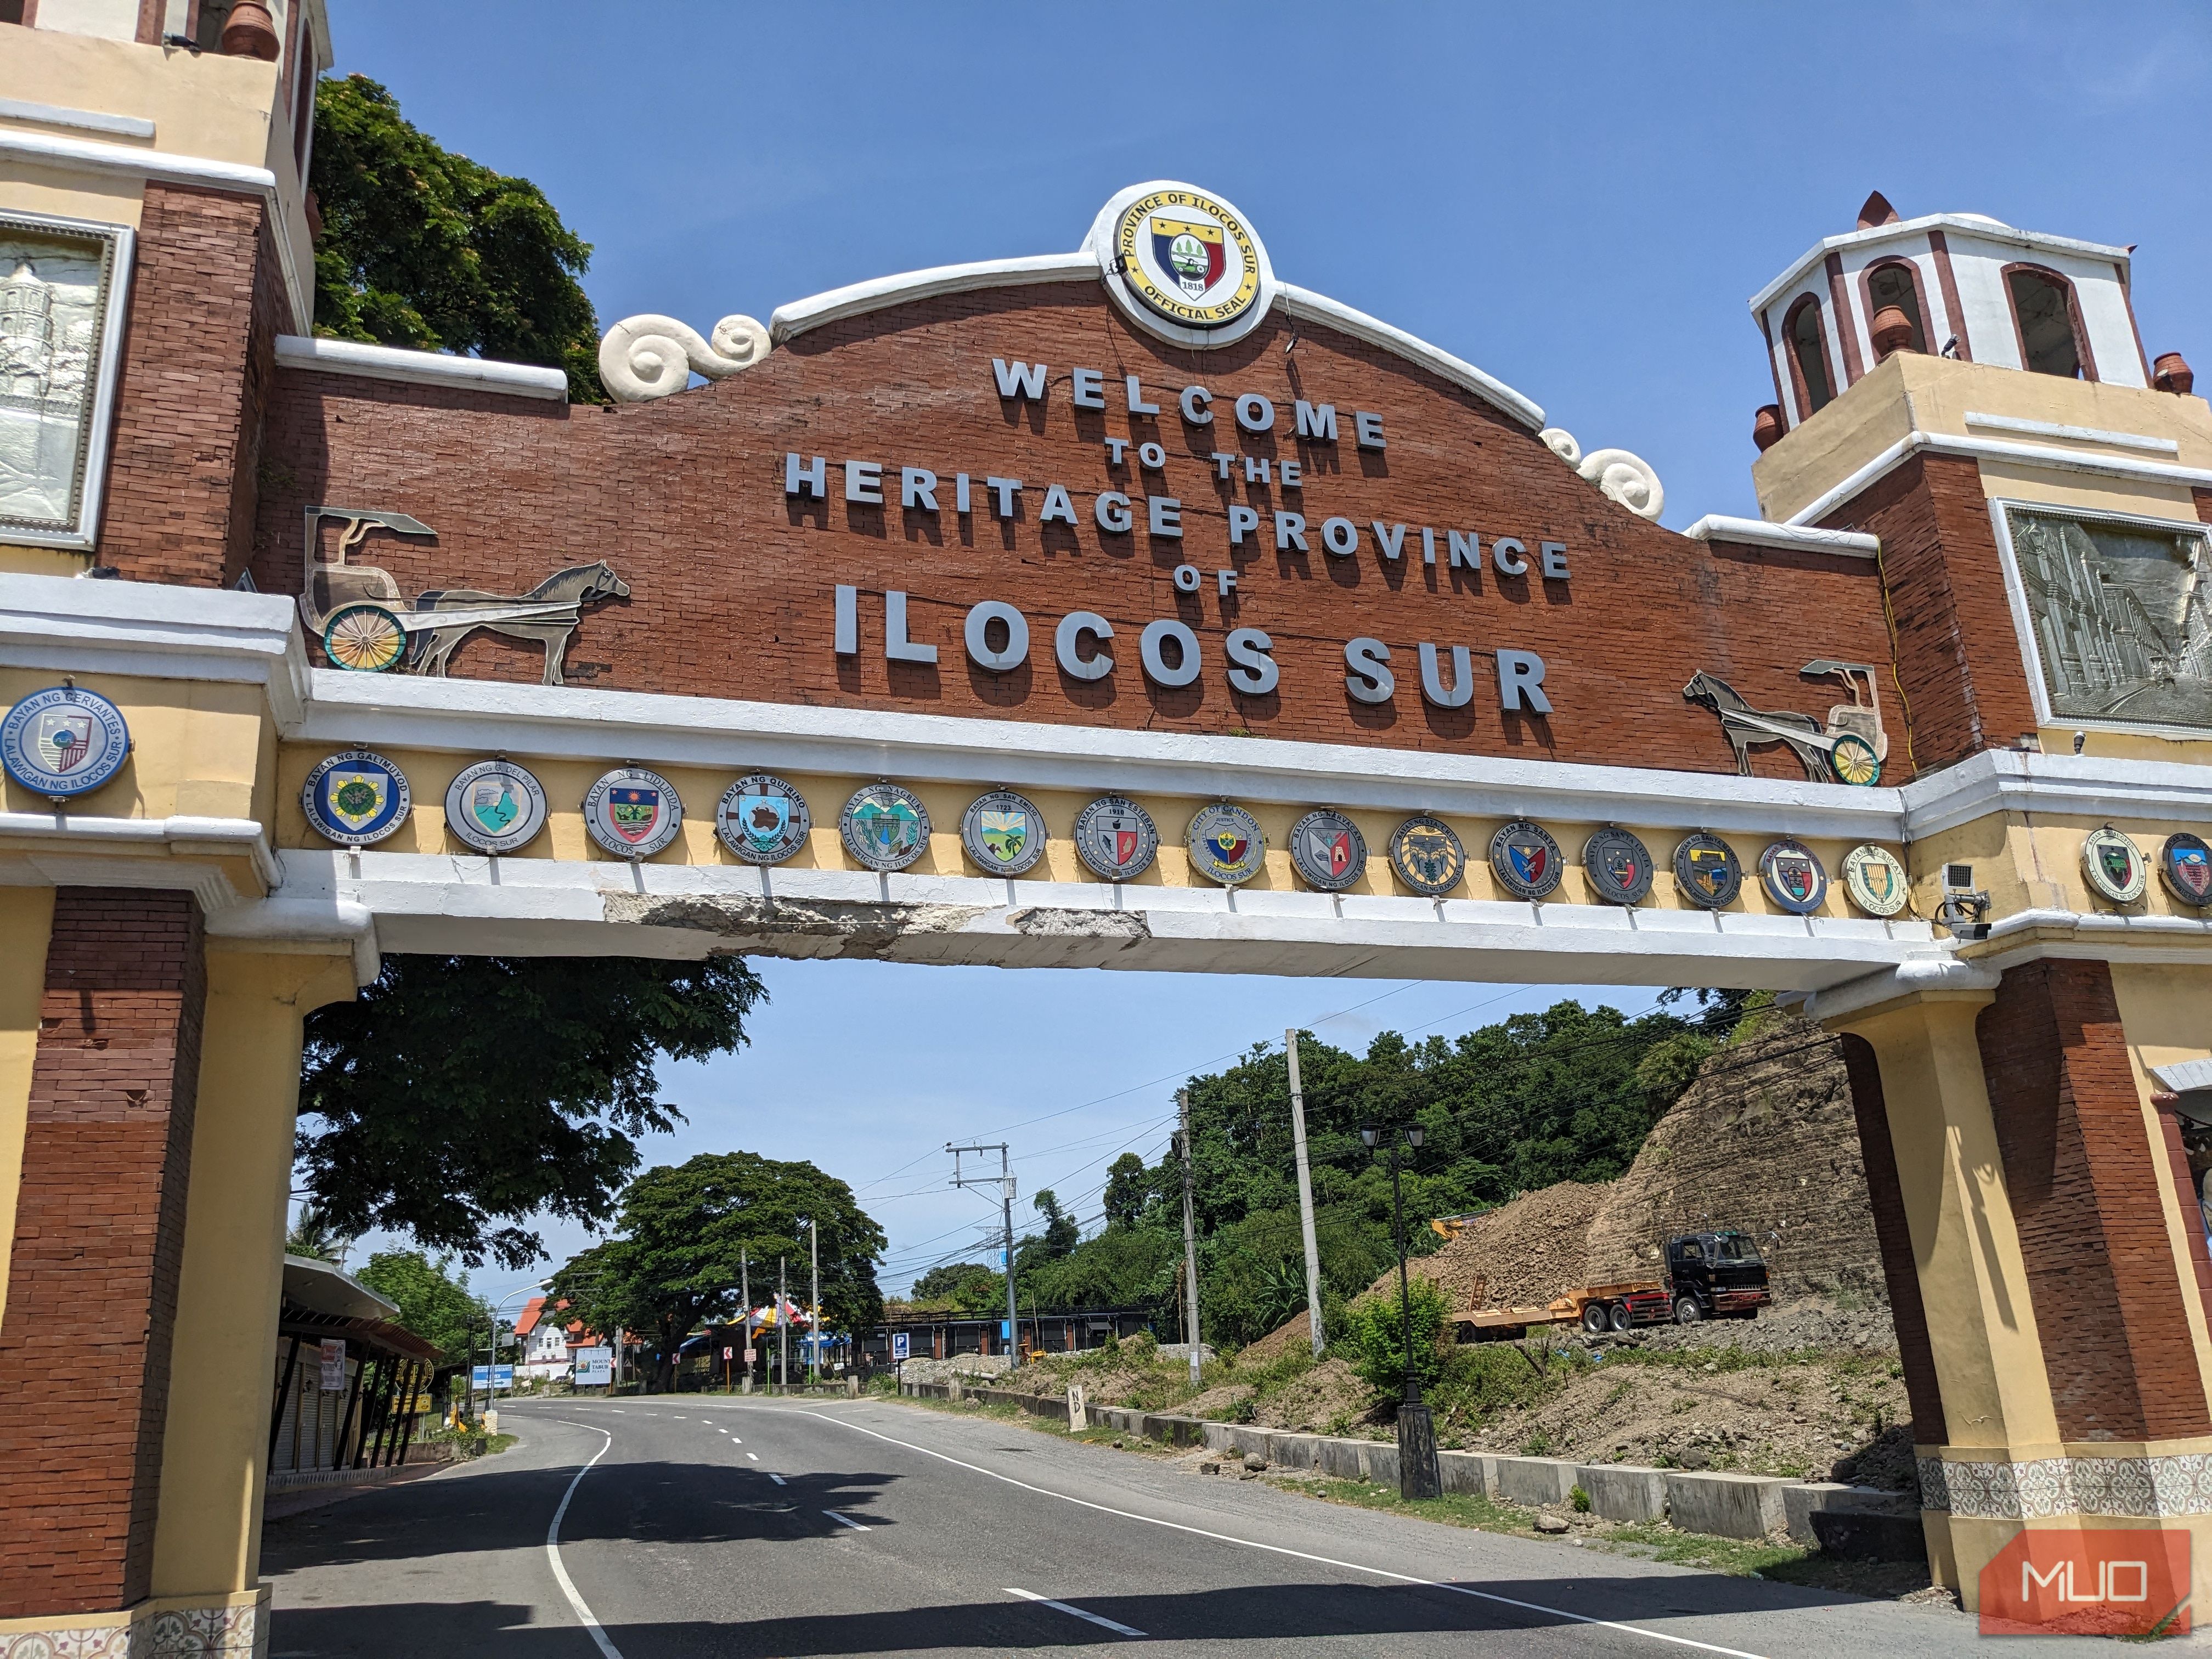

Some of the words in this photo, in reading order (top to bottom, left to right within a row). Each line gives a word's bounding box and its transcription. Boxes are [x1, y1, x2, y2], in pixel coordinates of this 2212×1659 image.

[1124, 196, 1163, 257] PROVINCE
[1168, 194, 1187, 204] OF
[1192, 197, 1245, 241] ILOCOS
[1240, 245, 1255, 274] SUR
[1182, 281, 1204, 291] 1818
[1144, 286, 1213, 319] OFFICIAL
[1215, 295, 1246, 318] SEAL
[991, 358, 1387, 450] WELCOME
[1104, 437, 1166, 470] TO
[1211, 452, 1302, 487] THE
[785, 452, 1183, 538] HERITAGE
[1227, 505, 1571, 580] PROVINCE
[1172, 565, 1238, 597] OF
[835, 584, 1279, 695] ILOCOS
[1344, 637, 1554, 715] SUR
[8, 699, 41, 729] BAYAN
[43, 693, 60, 703] NG
[65, 692, 121, 735] CERVANTES
[5, 738, 48, 787] LALAWIGAN
[50, 780, 67, 789] NG
[71, 763, 111, 788] ILOCOS
[108, 741, 122, 762] SUR
[308, 759, 335, 787] BAYAN
[337, 753, 353, 762] NG
[357, 753, 407, 792] GALIMUYOD
[455, 770, 478, 791] BAYAN
[479, 765, 492, 773] NG
[506, 766, 520, 778] DEL
[522, 775, 539, 796] PILAR
[588, 778, 609, 806] BAYAN
[618, 770, 633, 778] NG
[644, 772, 679, 811] LIDLIDDA
[721, 780, 748, 804] BAYAN
[770, 778, 805, 808] QUIRINO
[844, 792, 865, 817] BAYAN
[888, 786, 927, 821] NAGBUKEL
[970, 798, 987, 812] BAYAN
[1019, 800, 1037, 816] EMILIO
[1078, 807, 1094, 830] BAYAN
[1095, 800, 1107, 808] NG
[1128, 803, 1155, 834] ESTEBAN
[306, 803, 343, 840] LALAWIGAN
[364, 823, 396, 840] ILOCOS
[395, 806, 407, 821] SUR
[1193, 812, 1207, 830] CITY
[1223, 806, 1259, 831] CANDON
[1294, 817, 1310, 838] BAYAN
[1327, 812, 1362, 841] NARVACAN
[1397, 821, 1413, 840] BAYAN
[1441, 826, 1457, 843] CRUZ
[466, 832, 497, 845] ILOCOS
[500, 838, 519, 846] SUR
[601, 836, 634, 854] ILOCOS
[650, 838, 668, 851] SUR
[721, 827, 756, 860] LALAWIGAN
[771, 845, 797, 860] ILOCOS
[795, 831, 806, 845] SUR
[844, 833, 879, 867] LALAWIGAN
[895, 850, 920, 867] ILOCOS
[919, 836, 928, 850] SUR
[1496, 825, 1516, 847] BAYAN
[1534, 827, 1556, 851] SANTA
[1611, 832, 1633, 844] SANTA
[1635, 844, 1649, 867] LUCIA
[1679, 841, 1691, 859] BAYAN
[1701, 835, 1720, 845] SANTA
[1722, 844, 1737, 864] MARIA
[2089, 832, 2101, 845] BAYAN
[2113, 832, 2135, 849] SUGPON
[969, 846, 998, 871] LALAWIGAN
[1032, 848, 1042, 860] SUR
[1125, 862, 1146, 876] ILOCOS
[1767, 847, 1779, 863] BAYAN
[1792, 844, 1818, 866] SANTIAGO
[1849, 848, 1866, 872] BAYAN
[1882, 852, 1903, 876] SIGAY
[1207, 866, 1237, 879] ILOCOS
[1238, 868, 1253, 878] SUR
[1297, 858, 1326, 885] LALAWIGAN
[1340, 873, 1358, 887] ILOCOS
[1398, 862, 1427, 890] LALAWIGAN
[1439, 877, 1458, 891] ILOCOS
[1499, 869, 1526, 894] LALAWIGAN
[1537, 883, 1554, 894] ILOCOS
[2091, 871, 2118, 898] LALAWIGAN
[2128, 886, 2142, 899] ILOCOS
[1605, 887, 1629, 899] ILOCOS
[1632, 889, 1644, 898] SUR
[1722, 891, 1736, 904] ILOCOS
[1863, 900, 1889, 913] ILOCOS
[1889, 901, 1902, 912] SUR
[898, 1337, 904, 1346] P
